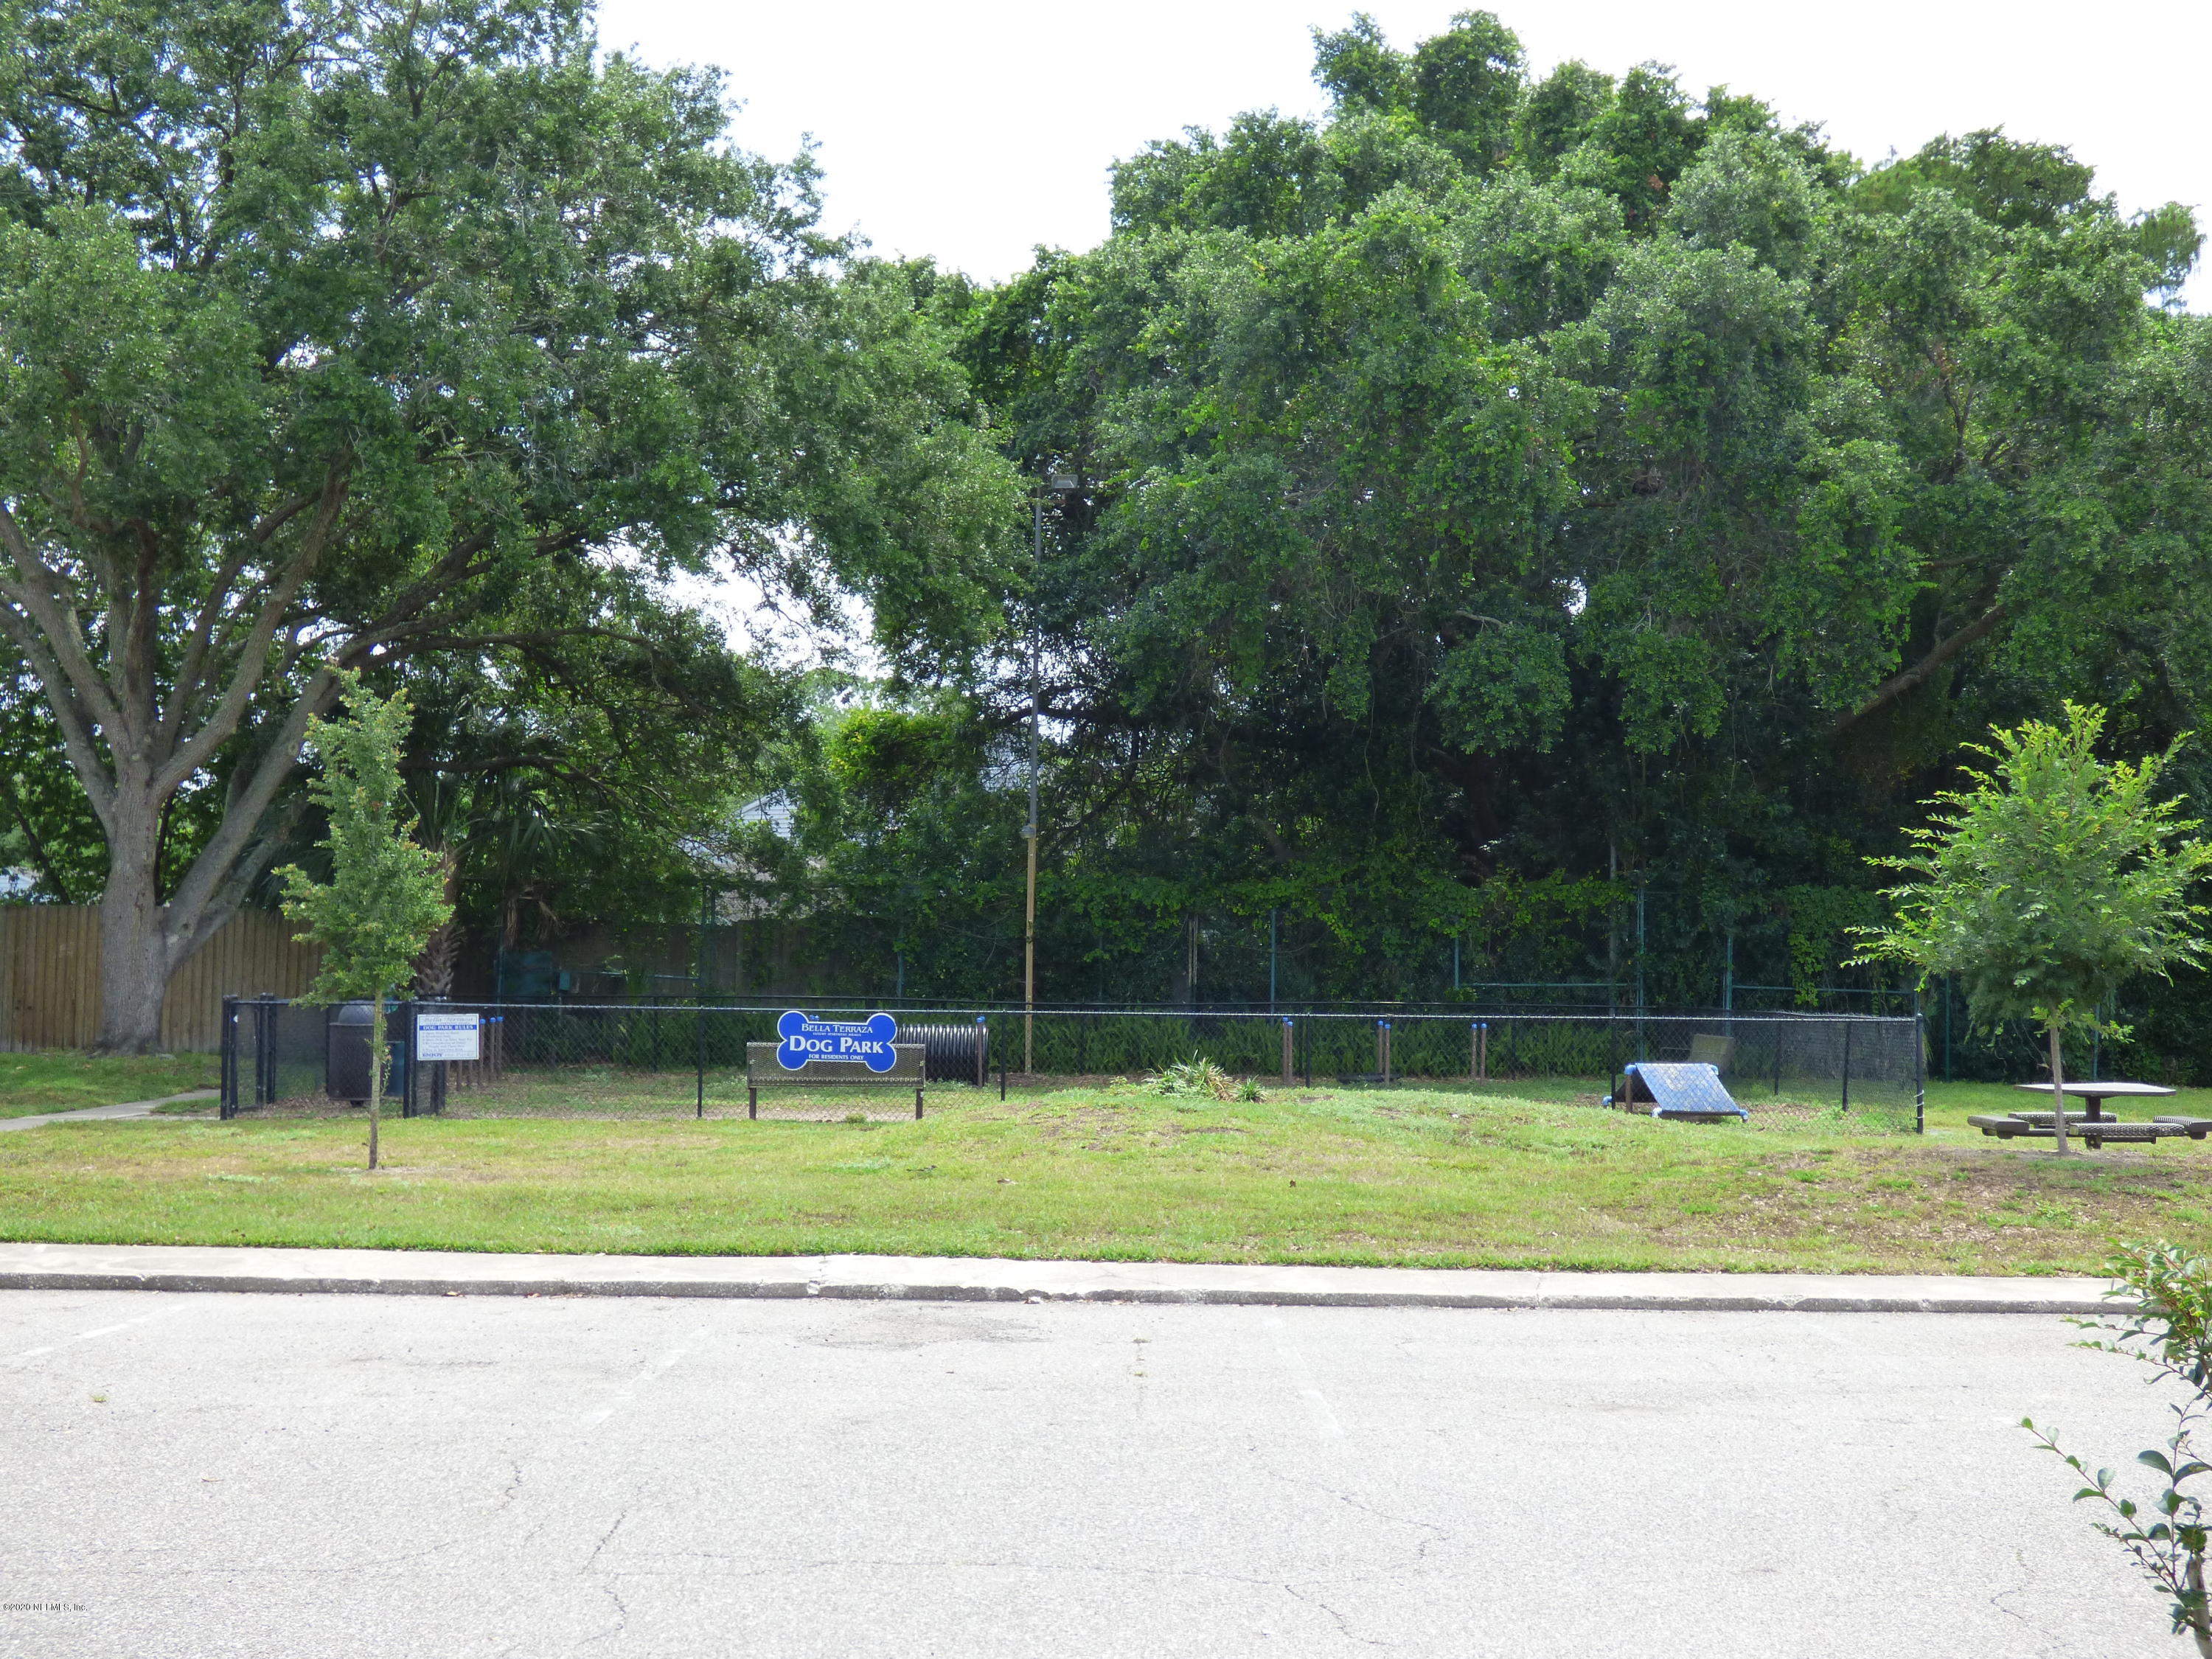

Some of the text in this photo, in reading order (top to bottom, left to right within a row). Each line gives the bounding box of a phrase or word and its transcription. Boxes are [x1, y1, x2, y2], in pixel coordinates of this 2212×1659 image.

[801, 1023, 873, 1033] BELLA TERRAZA
[790, 1035, 883, 1054] DOG PARK
